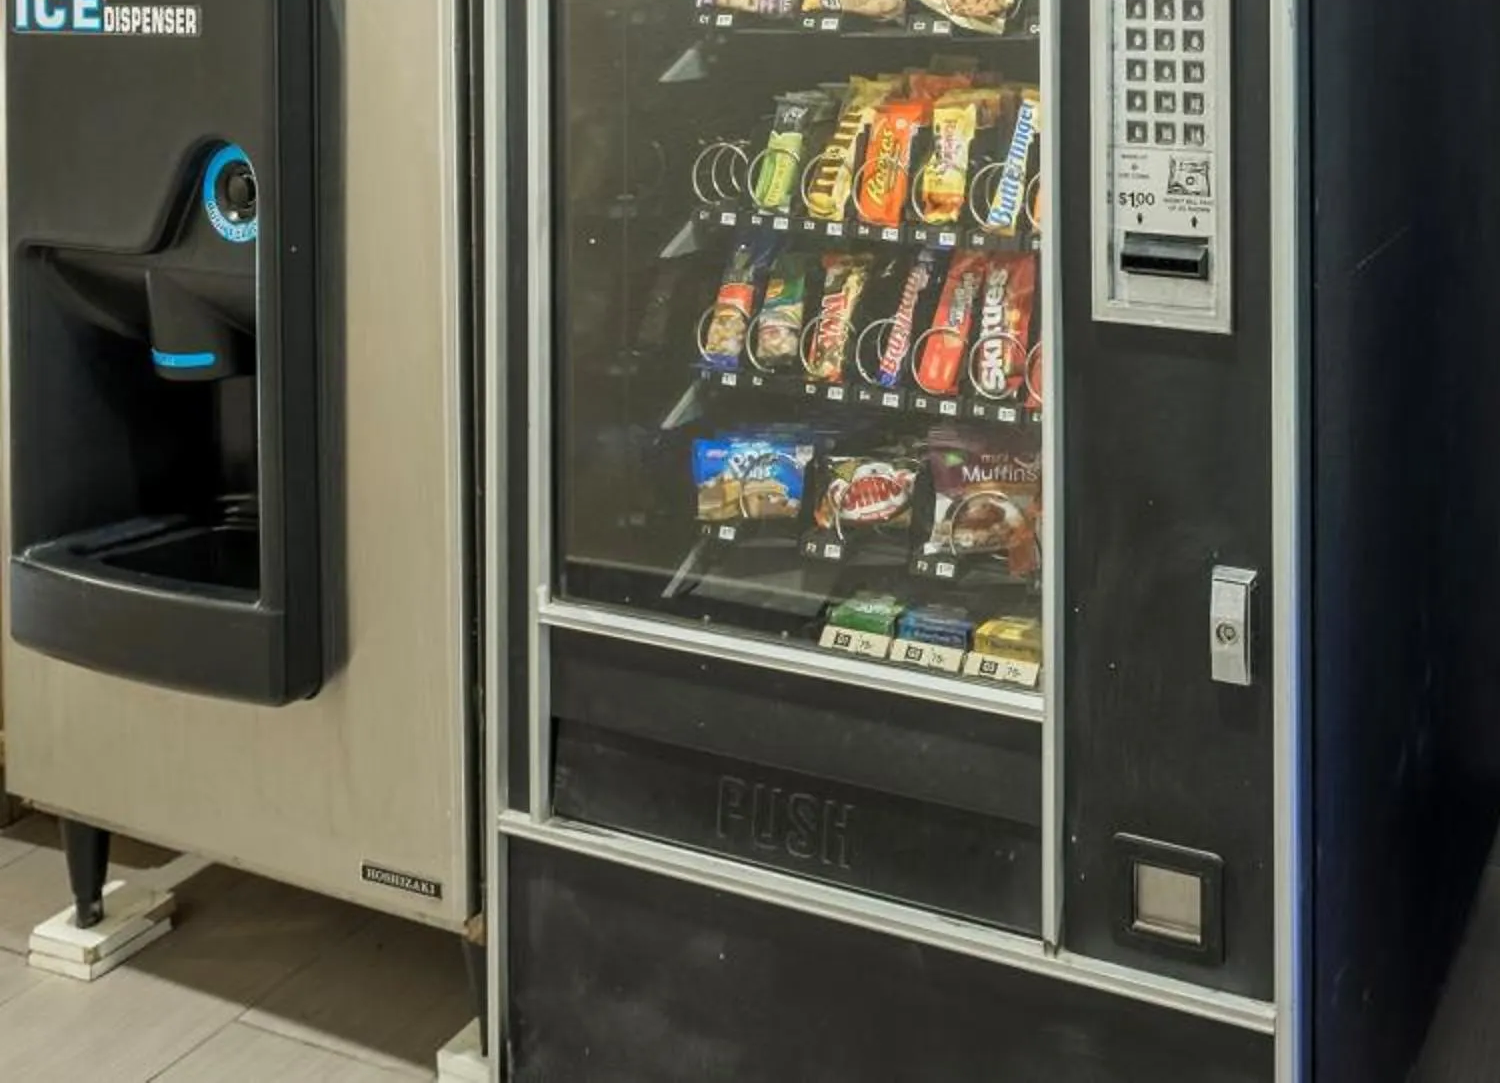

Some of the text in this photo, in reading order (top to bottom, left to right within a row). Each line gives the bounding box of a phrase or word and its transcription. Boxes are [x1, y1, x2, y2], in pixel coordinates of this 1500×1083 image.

[103, 5, 197, 35] DISPENSER
[961, 466, 1038, 482] Muffins
[716, 774, 856, 869] PUSH
